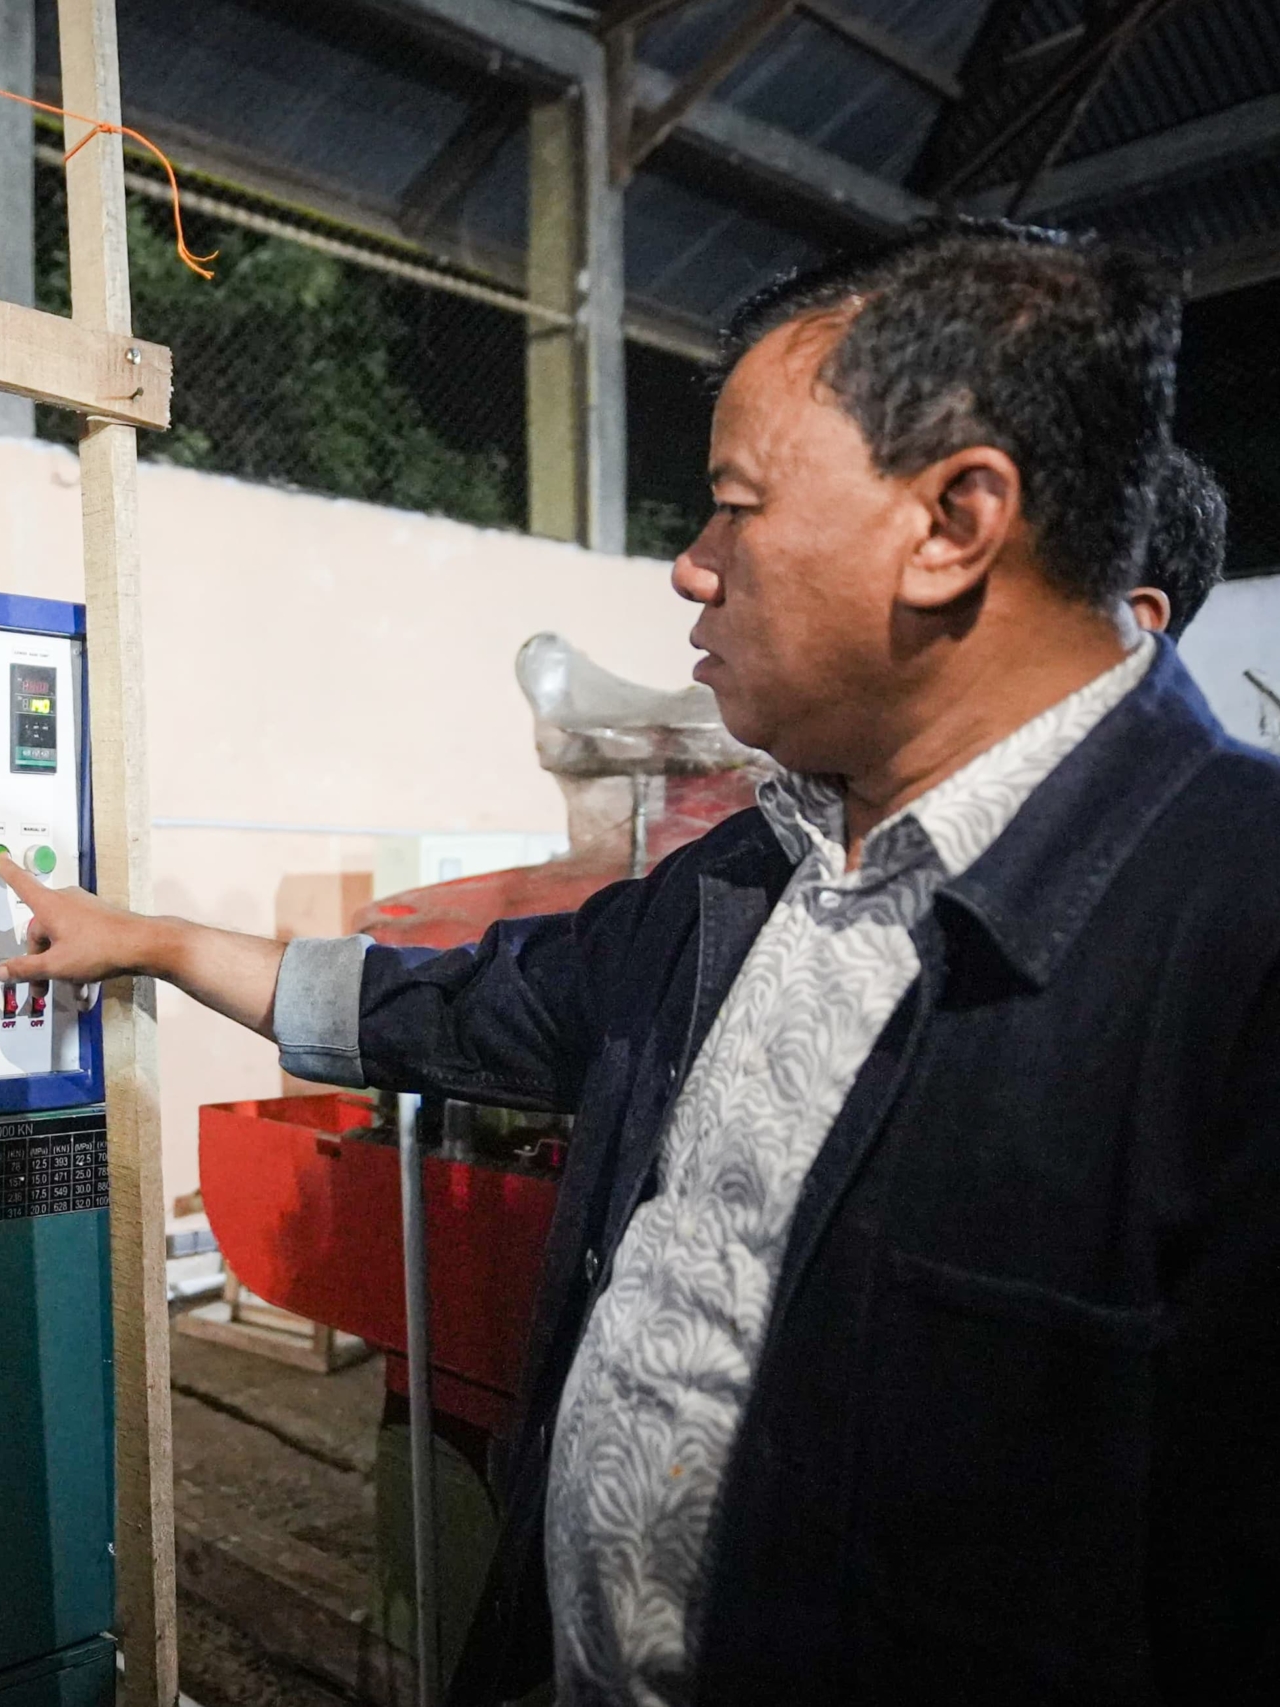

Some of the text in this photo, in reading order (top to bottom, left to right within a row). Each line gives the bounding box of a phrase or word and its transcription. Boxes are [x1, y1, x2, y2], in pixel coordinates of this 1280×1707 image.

[2, 1020, 16, 1029] OFF
[30, 1020, 44, 1028] OFF
[17, 1124, 34, 1135] KN
[8, 1150, 25, 1158] (KN)
[30, 1147, 48, 1156] (MPa)
[54, 1145, 69, 1154] (KN)
[75, 1143, 92, 1151] (MPa)
[32, 1159, 47, 1169] 12.5
[55, 1157, 68, 1166] 393
[76, 1154, 91, 1165] 22.5
[32, 1175, 47, 1184] 15.0
[54, 1172, 68, 1181] 471
[75, 1169, 91, 1179] 25.0
[32, 1190, 47, 1199] 17.5
[54, 1187, 68, 1196] 549
[75, 1184, 91, 1194] 30.0
[9, 1208, 22, 1218] 314
[30, 1205, 46, 1214] 20.0
[54, 1202, 67, 1211] 628
[75, 1198, 91, 1208] 32.0
